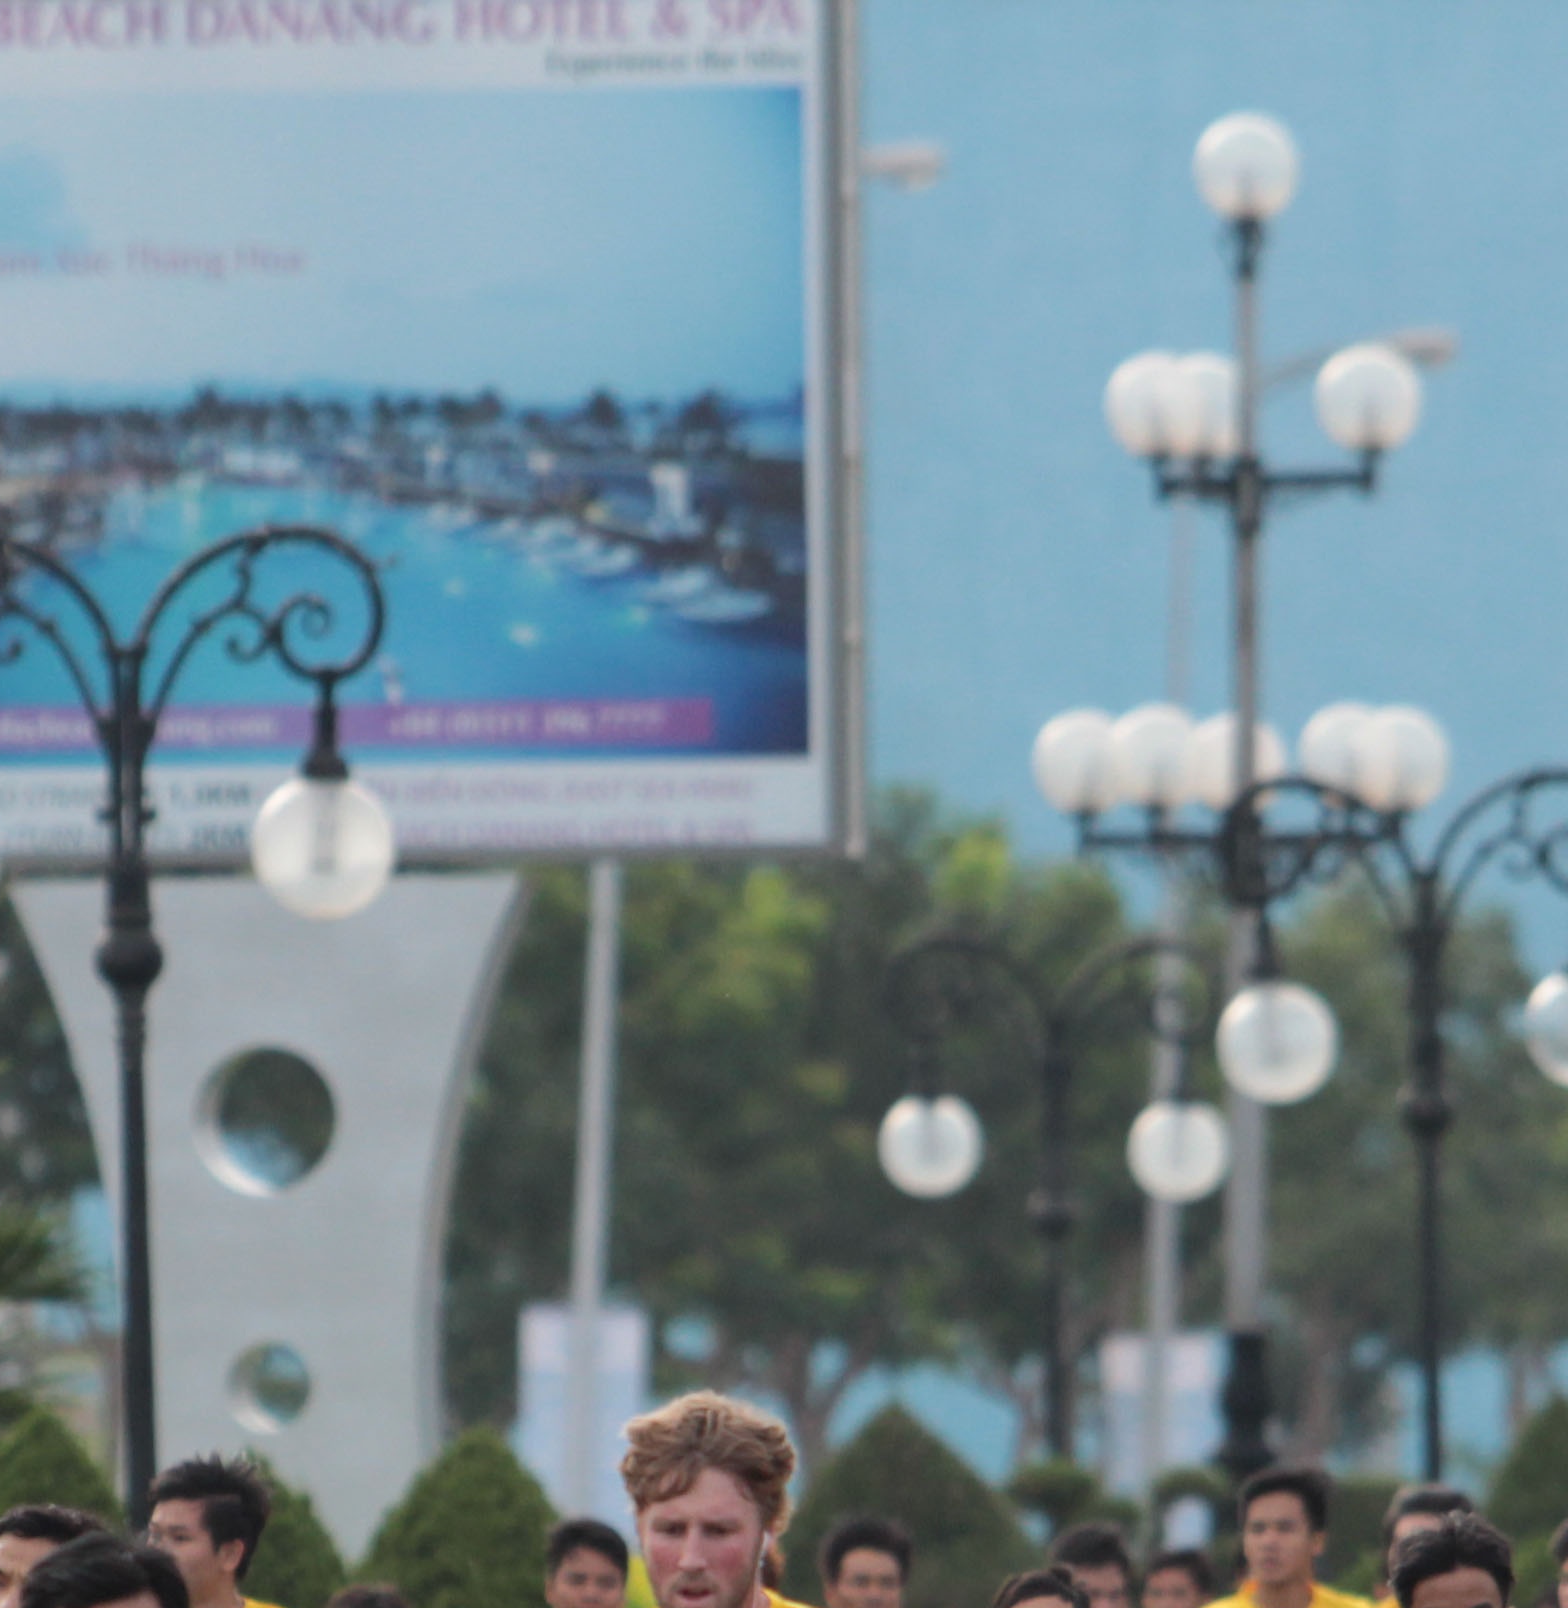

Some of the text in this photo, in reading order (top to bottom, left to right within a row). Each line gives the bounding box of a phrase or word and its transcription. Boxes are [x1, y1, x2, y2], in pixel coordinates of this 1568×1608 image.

[185, 0, 435, 46] DANANG
[451, 0, 628, 43] HOTEL
[648, 0, 691, 38] &
[706, 0, 801, 37] SPA
